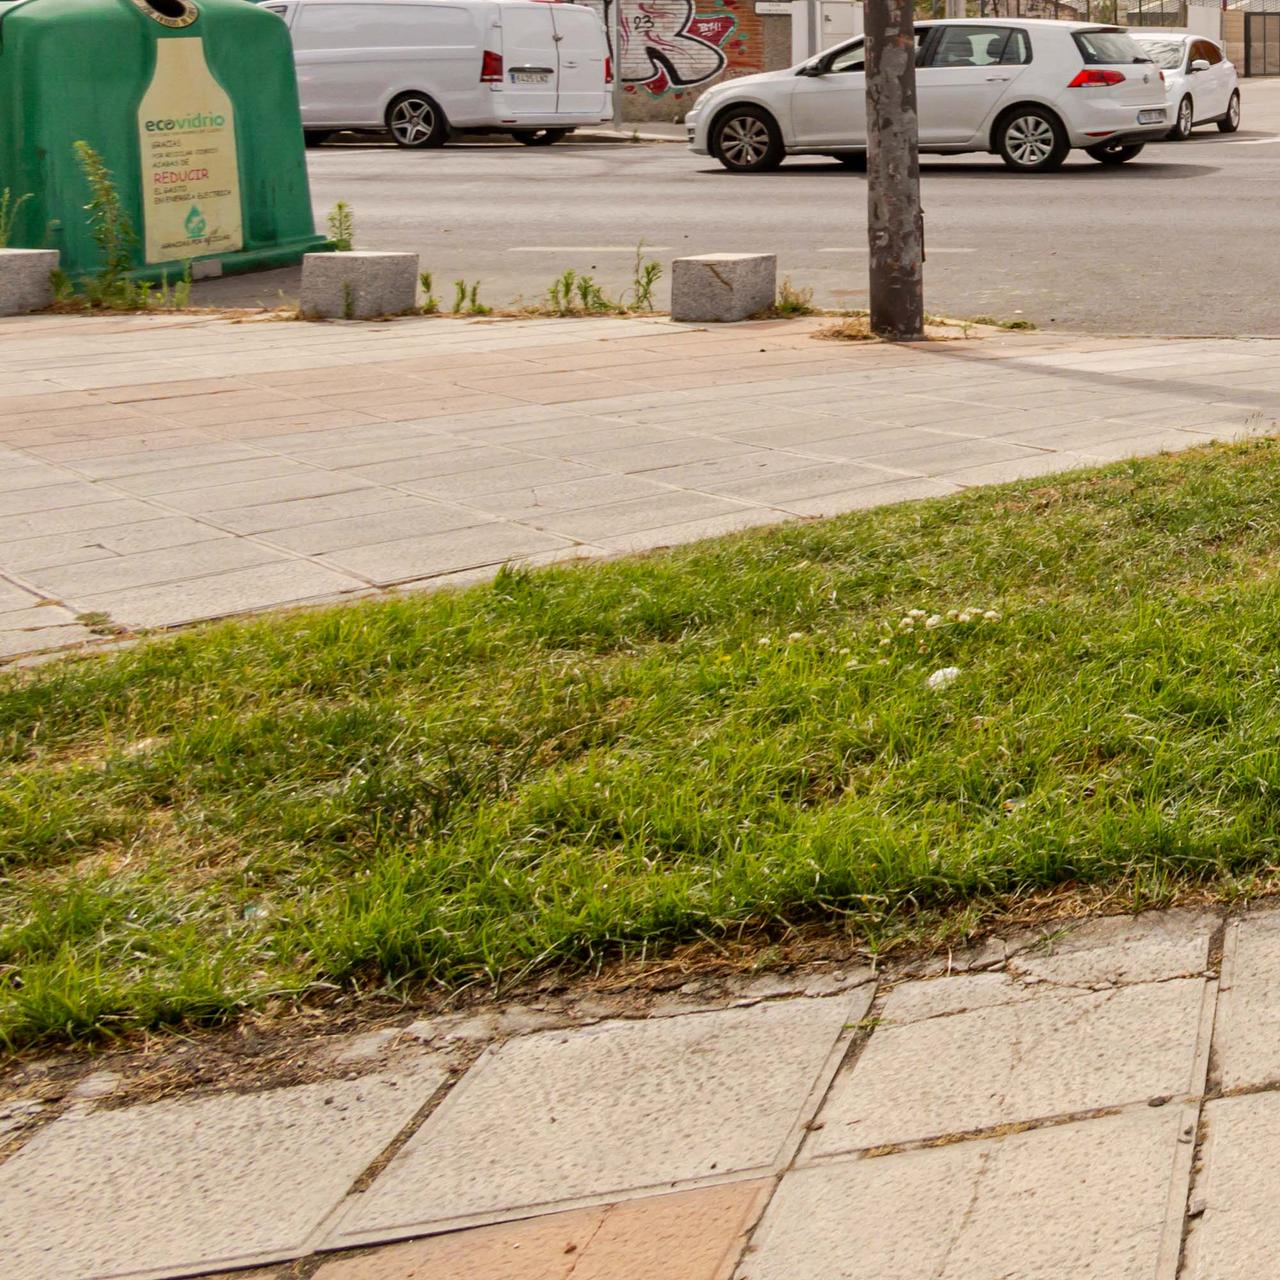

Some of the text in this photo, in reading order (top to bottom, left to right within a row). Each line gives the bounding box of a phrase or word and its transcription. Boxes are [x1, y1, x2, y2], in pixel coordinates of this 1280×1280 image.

[634, 15, 654, 30] 23
[145, 111, 225, 132] ecovidrio
[153, 168, 209, 185] REDUCIR
